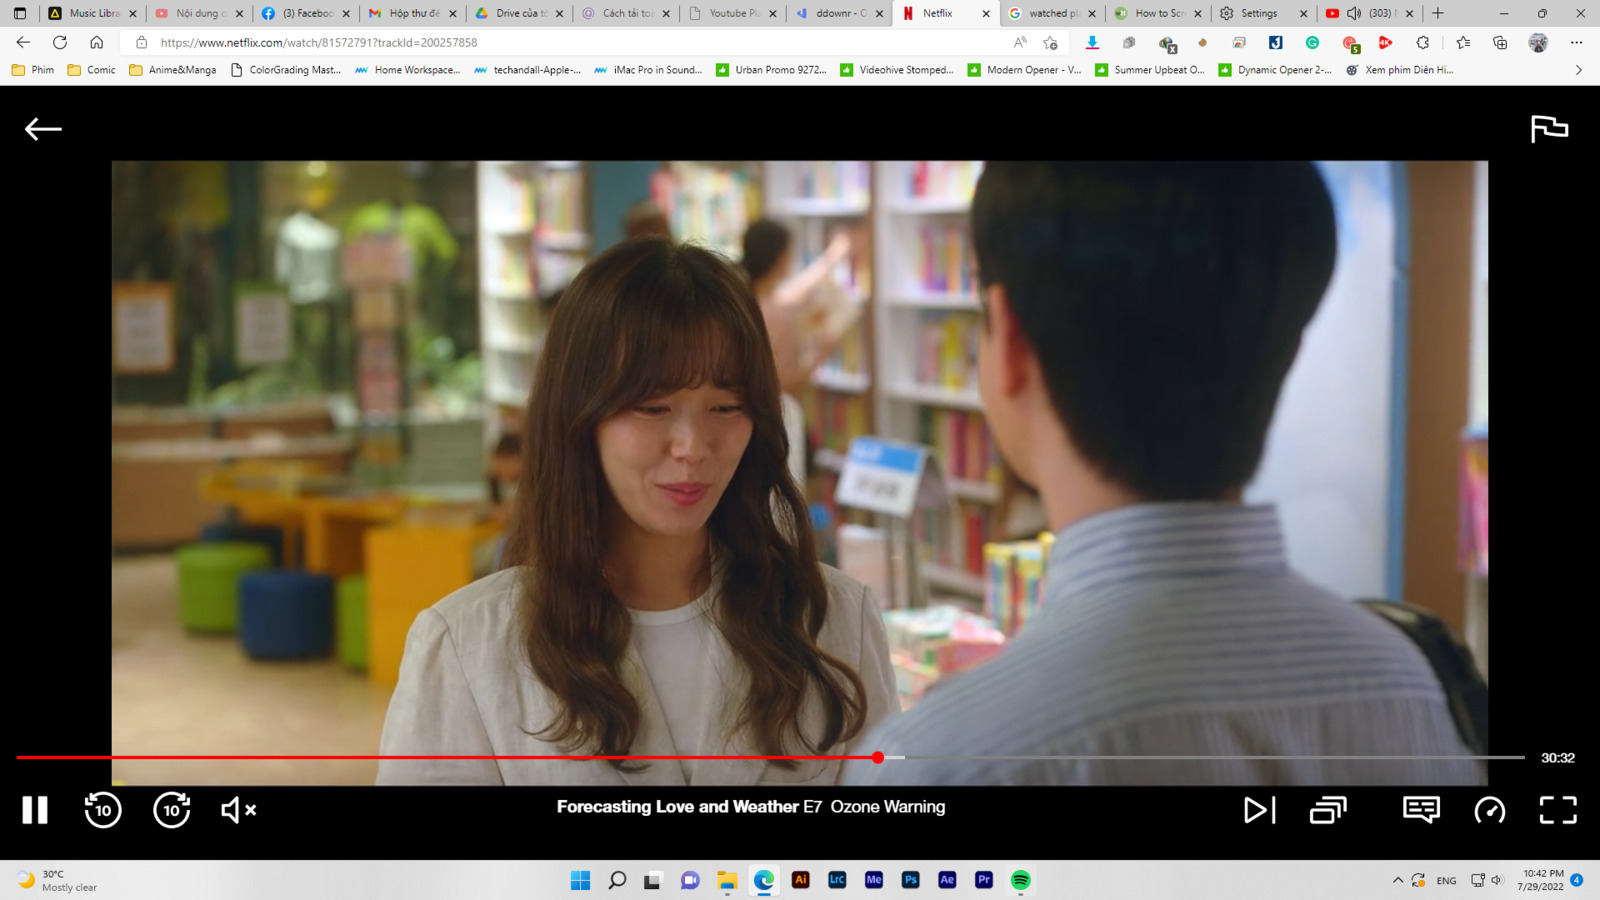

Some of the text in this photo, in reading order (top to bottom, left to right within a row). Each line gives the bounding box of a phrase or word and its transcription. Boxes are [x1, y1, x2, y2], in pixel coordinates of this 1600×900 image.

[70, 8, 96, 18] Music
[176, 8, 193, 19] Nội
[194, 8, 219, 21] dung
[283, 8, 296, 20] (3)
[389, 8, 410, 20] Hộp
[411, 8, 428, 18] thư
[496, 8, 521, 18] Drive
[521, 7, 539, 18] của
[602, 8, 626, 18] Cách
[627, 7, 639, 18] tải
[709, 8, 748, 18] Youtube
[816, 8, 852, 18] ddownr
[923, 8, 953, 18] Netflix
[1029, 8, 1068, 18] watched
[1135, 8, 1157, 18] How
[1158, 8, 1169, 18] to
[1241, 8, 1278, 21] Settings
[1368, 8, 1392, 20] (303)
[31, 64, 55, 75] Phim
[87, 64, 116, 75] Comic
[149, 64, 217, 77] Anime&Manga
[249, 64, 342, 77] ColorGrading Mast...
[374, 65, 461, 77] Home Workspace...
[614, 64, 703, 75] iMac Pro in Sound...
[735, 64, 827, 75] Urban Promo 9272...
[859, 64, 954, 77] Videohive Stomped...
[987, 64, 1023, 75] Modern
[1024, 64, 1060, 77] Opener
[1114, 64, 1153, 75] Summer
[1155, 64, 1188, 77] Upbeat
[1238, 64, 1278, 77] Dynamic
[1279, 64, 1314, 77] Opener
[1365, 65, 1386, 75] Xem
[1388, 64, 1411, 77] phim
[1540, 751, 1576, 764] 30:32
[95, 805, 112, 817] 10
[163, 805, 180, 817] 10
[556, 799, 946, 817] Forecasting Love and Weather E7 Ozone Warning
[42, 869, 65, 879] 30°C
[795, 874, 807, 884] Ai
[866, 874, 882, 884] Me
[940, 874, 955, 884] Ae
[978, 874, 990, 884] Pr
[1523, 869, 1565, 878] 10:42 PM
[905, 875, 917, 884] Ps
[1436, 876, 1457, 886] ENG
[42, 882, 98, 895] Mostly clear
[1517, 882, 1565, 893] 7/29/2022
